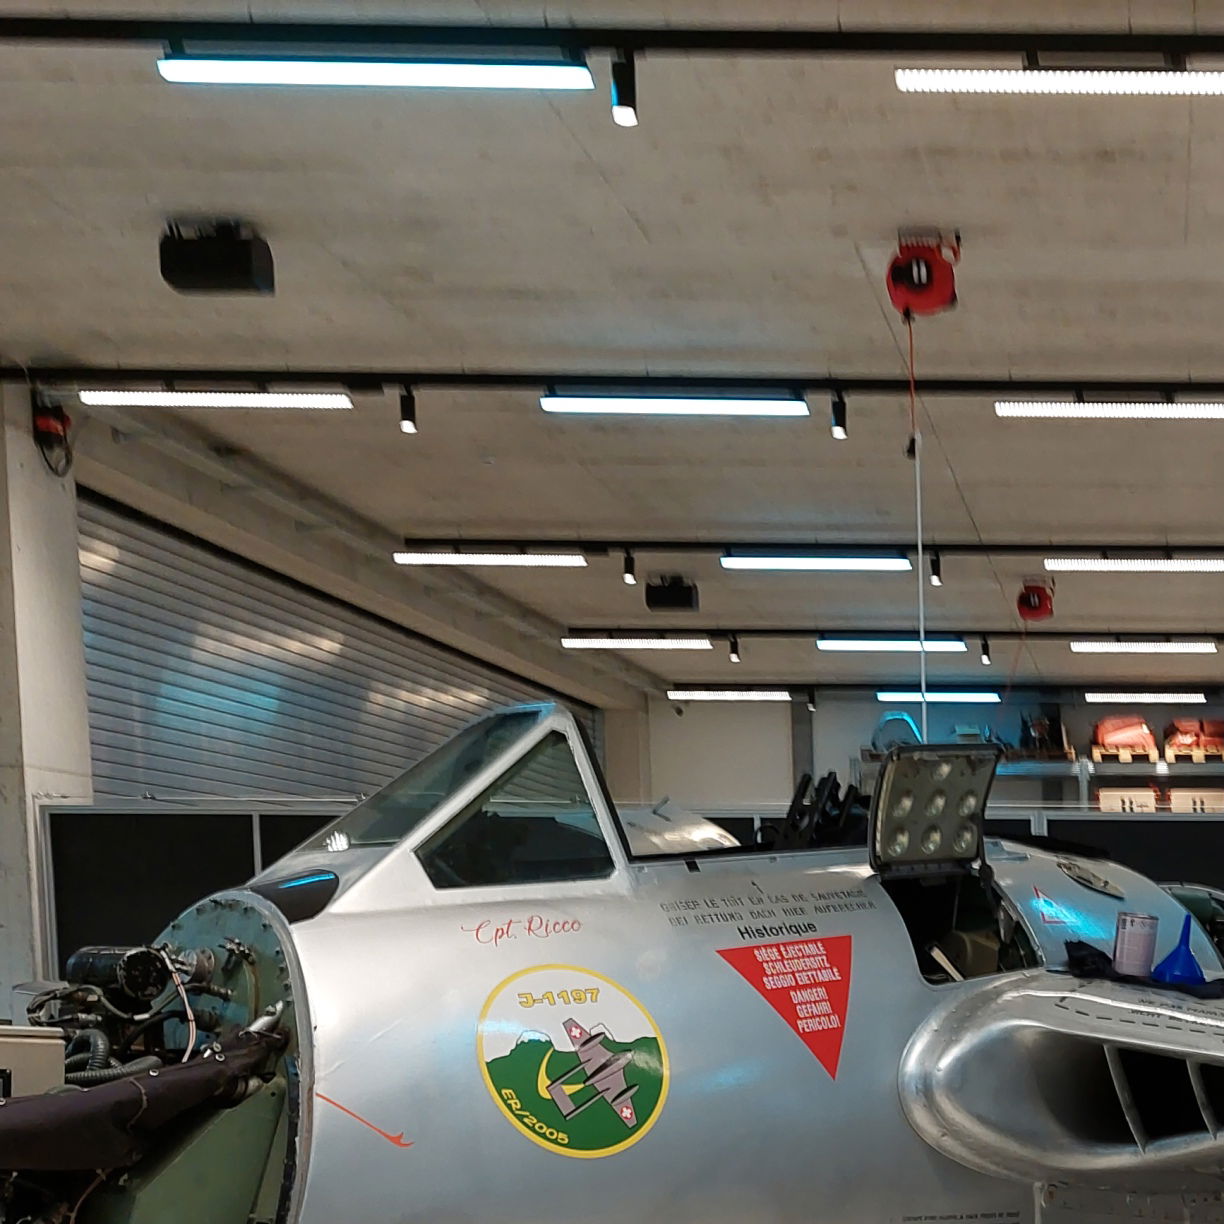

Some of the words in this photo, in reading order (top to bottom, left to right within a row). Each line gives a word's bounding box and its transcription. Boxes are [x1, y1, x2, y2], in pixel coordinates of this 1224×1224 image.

[703, 898, 720, 909] LE
[461, 919, 522, 947] Cpt.
[523, 914, 584, 939] Ricco
[737, 921, 818, 940] Historique
[762, 955, 831, 975] SCHLEUDERSITZ
[762, 974, 797, 990] SEGGIO
[517, 987, 601, 1009] J-1197
[789, 986, 829, 1004] DANGER!
[795, 1001, 833, 1019] GEFAHR!
[796, 1014, 842, 1034] PERICOLO!
[501, 1088, 569, 1145] ER/2005
